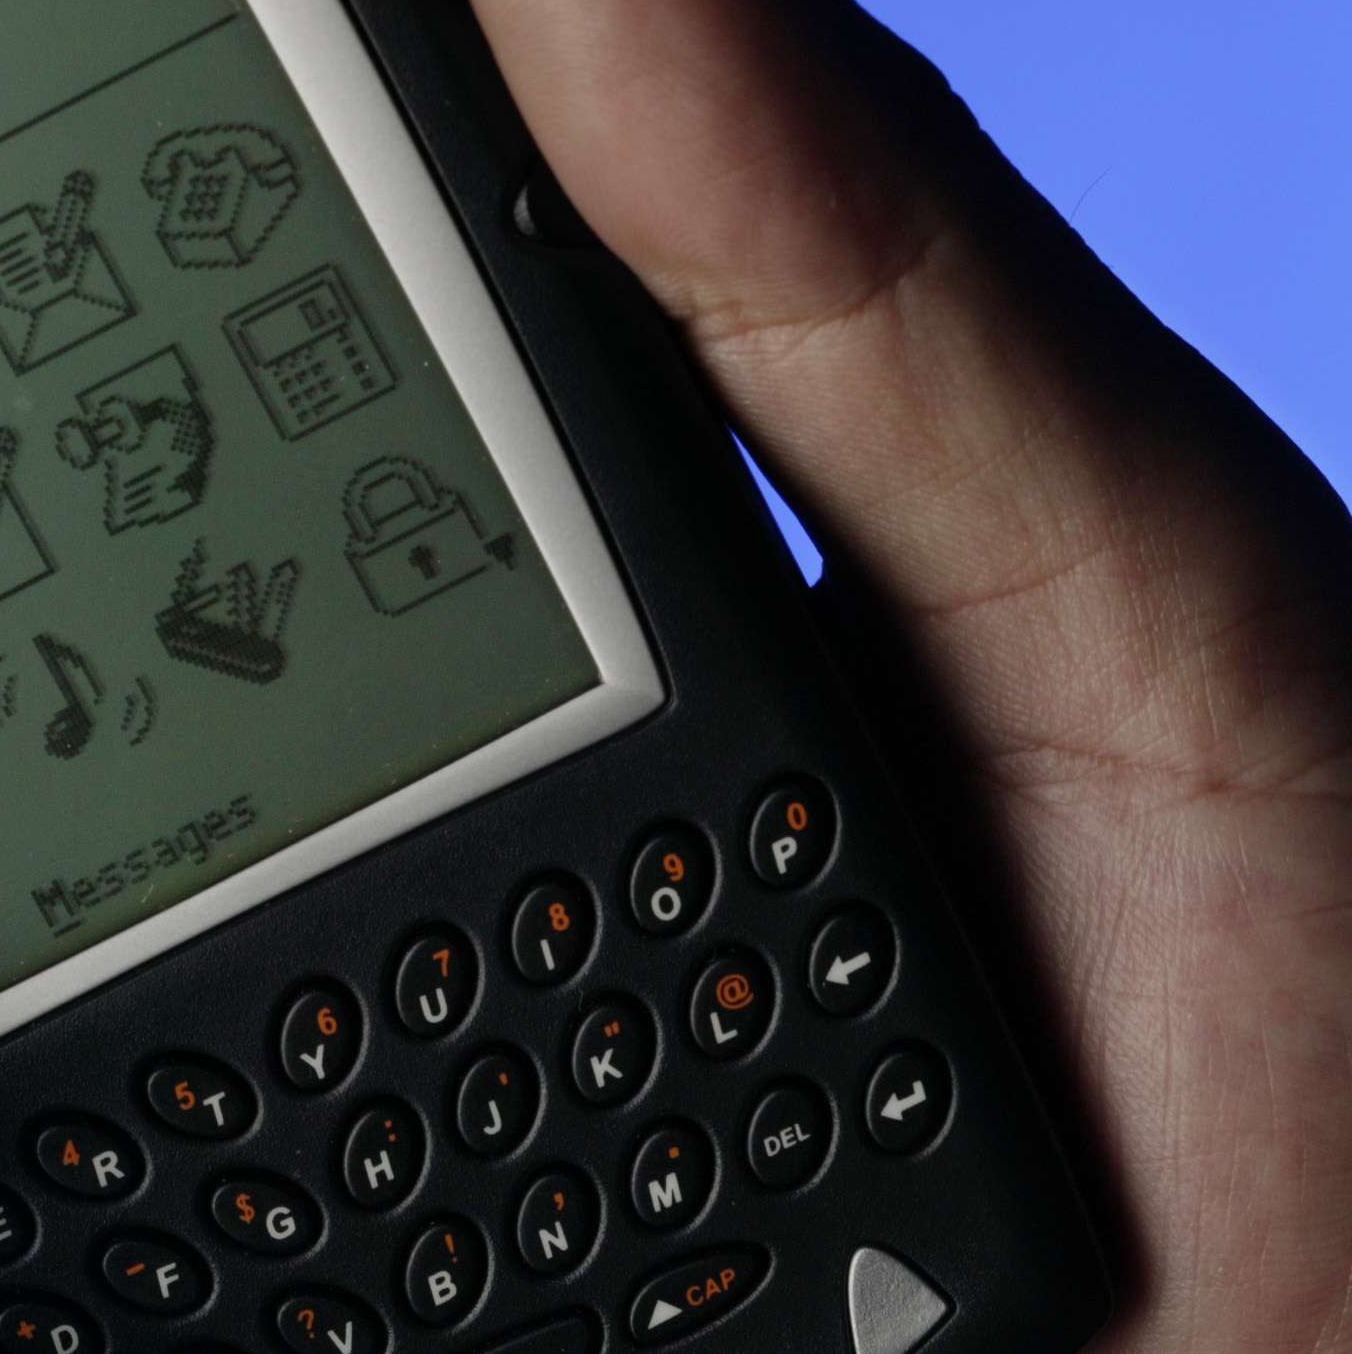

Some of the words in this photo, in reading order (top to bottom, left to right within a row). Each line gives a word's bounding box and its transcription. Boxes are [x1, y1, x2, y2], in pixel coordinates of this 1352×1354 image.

[786, 801, 808, 830] 0
[30, 793, 258, 938] Messages
[663, 853, 685, 881] 9
[771, 836, 798, 874] P
[548, 902, 570, 931] 8
[651, 886, 682, 921] O
[432, 947, 452, 979] 7
[540, 939, 555, 971] I
[419, 987, 448, 1024] U
[715, 973, 753, 1010] @
[318, 1008, 337, 1034] 6
[710, 1012, 738, 1044] L
[299, 1044, 325, 1079] Y
[590, 1048, 623, 1088] K
[174, 1082, 196, 1110] 5
[202, 1091, 226, 1126] T
[483, 1100, 502, 1135] J
[62, 1140, 80, 1164] 4
[763, 1123, 811, 1157] DEL
[92, 1150, 125, 1188] R
[363, 1150, 395, 1190] H
[235, 1193, 254, 1222] $
[648, 1172, 682, 1213] M
[266, 1206, 296, 1240] G
[538, 1220, 569, 1259] N
[443, 1232, 457, 1263] !
[156, 1262, 179, 1299] F
[427, 1270, 457, 1306] B
[685, 1267, 737, 1307] CAP
[296, 1307, 318, 1341] ?
